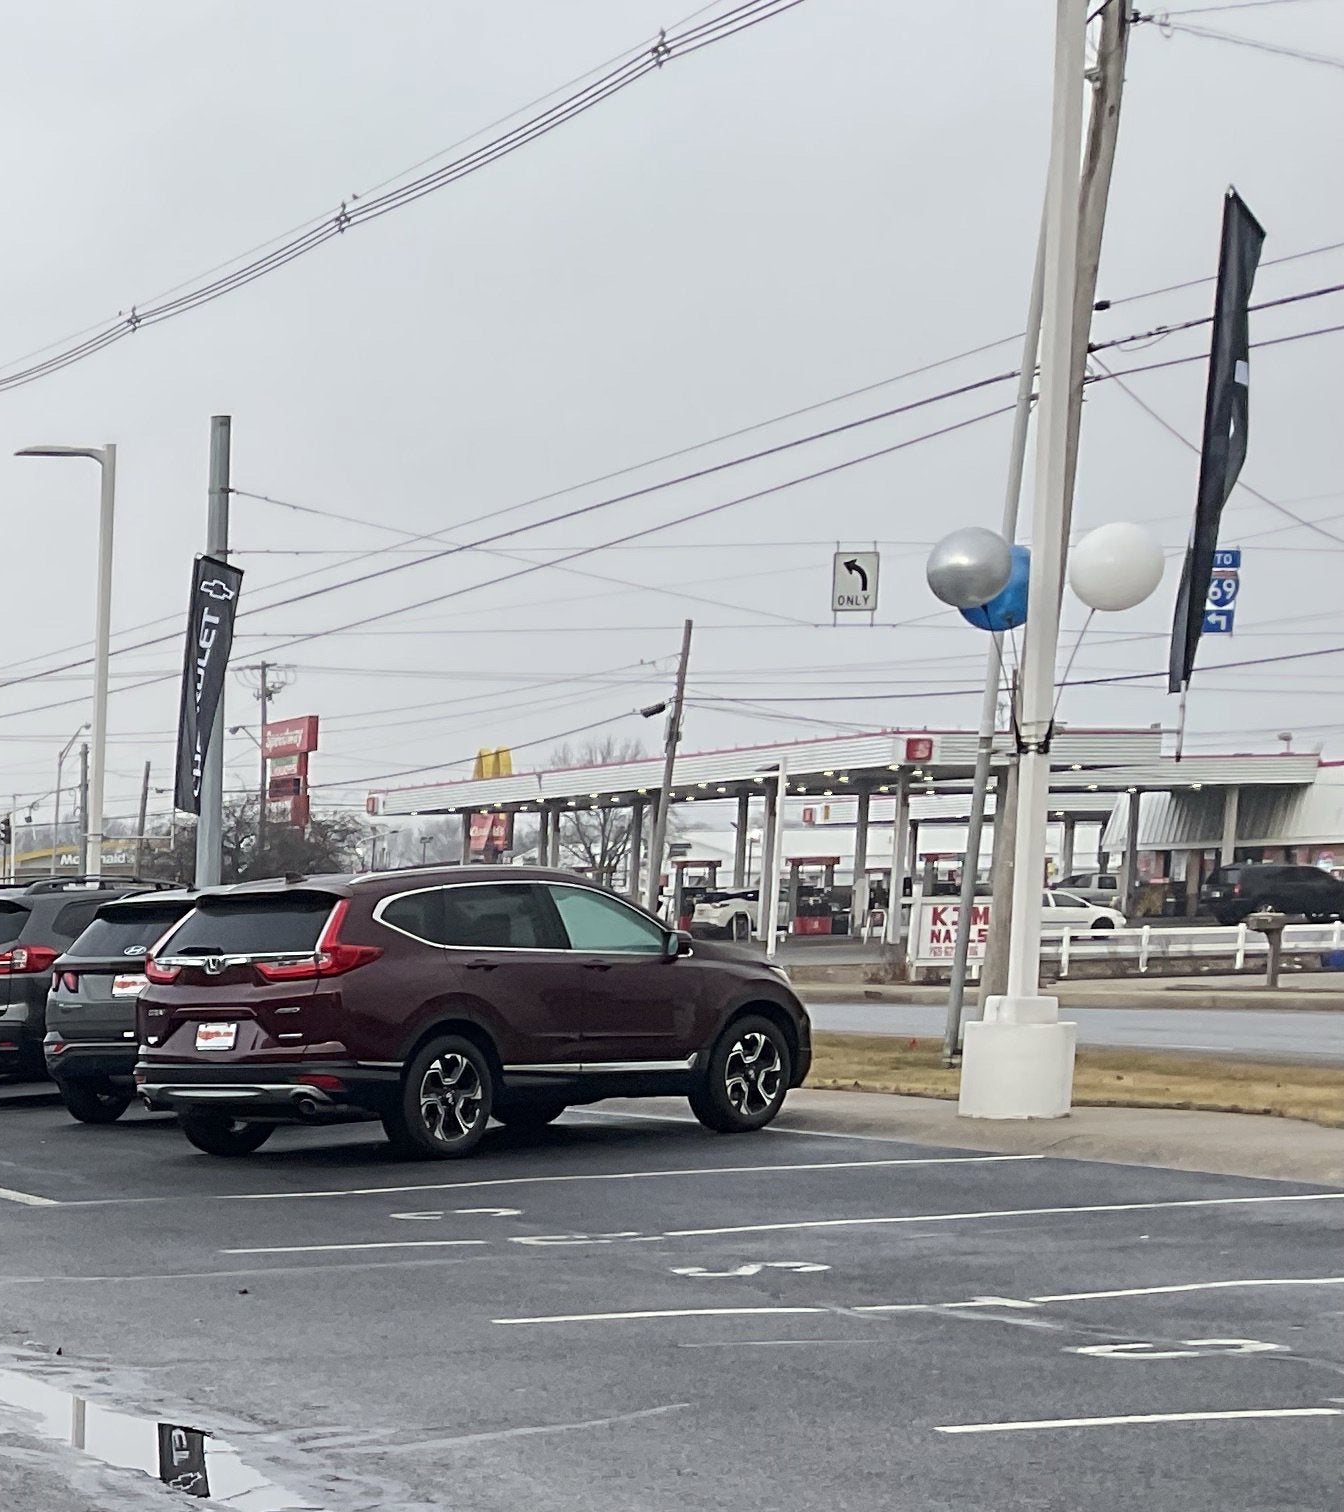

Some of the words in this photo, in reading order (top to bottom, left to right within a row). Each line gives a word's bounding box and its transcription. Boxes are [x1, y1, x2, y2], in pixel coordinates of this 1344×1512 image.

[1215, 553, 1233, 565] TO
[1208, 579, 1236, 601] 69
[837, 594, 871, 606] ONLY
